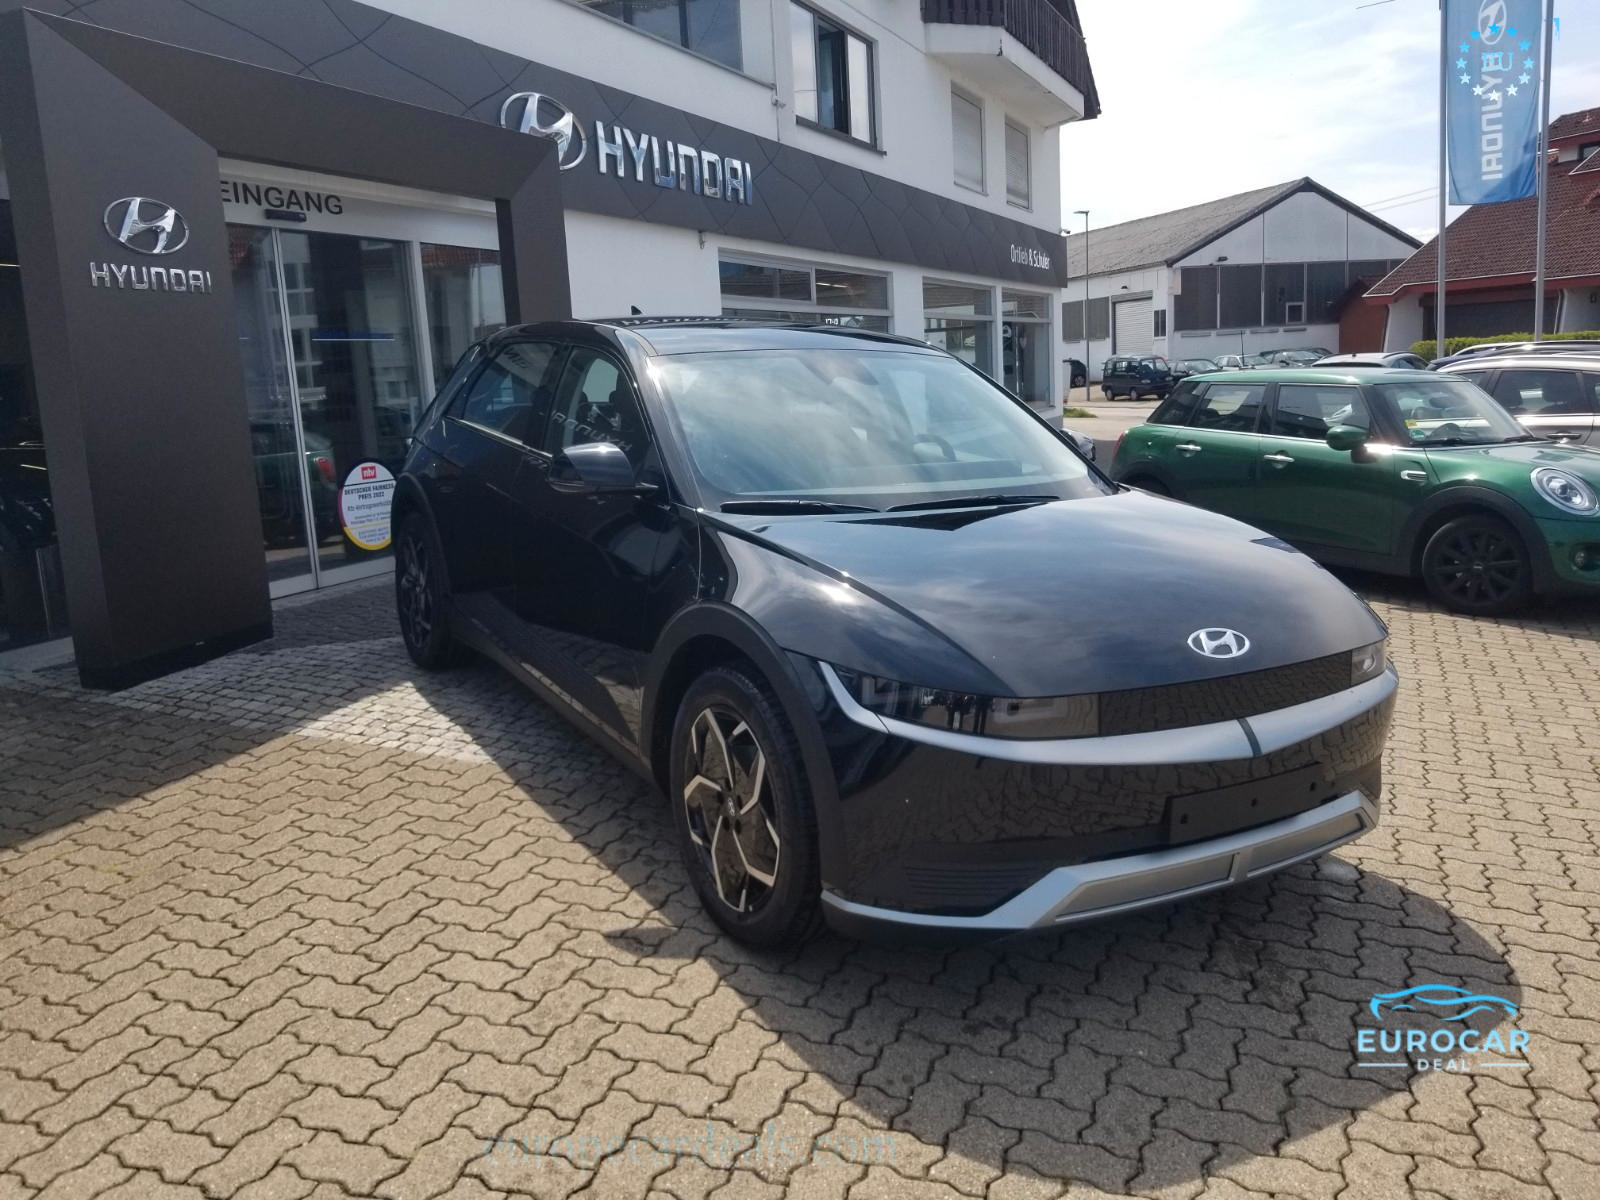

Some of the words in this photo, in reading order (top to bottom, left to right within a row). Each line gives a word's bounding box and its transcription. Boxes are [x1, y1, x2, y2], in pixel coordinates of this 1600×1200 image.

[595, 120, 752, 205] HYUNDAI
[220, 180, 344, 215] EINGANG
[1029, 249, 1033, 266] &
[1033, 251, 1050, 269] Schuler
[89, 261, 212, 293] HYUNDAI
